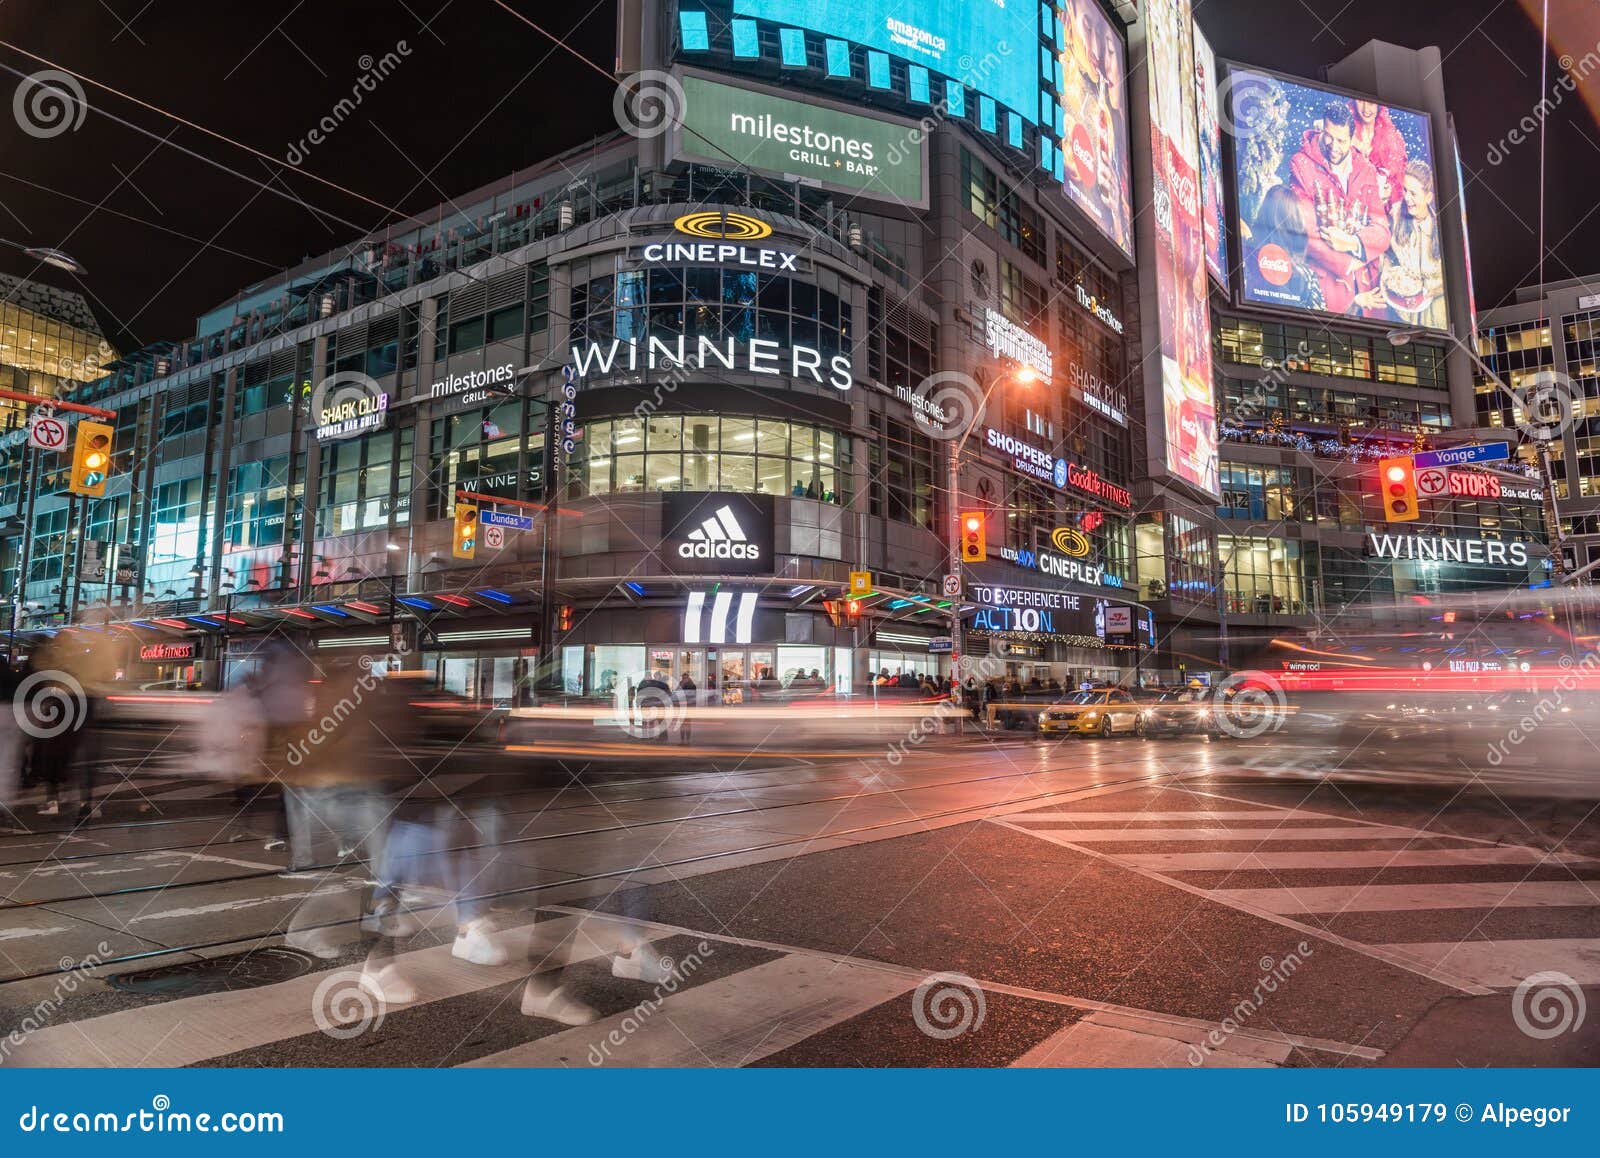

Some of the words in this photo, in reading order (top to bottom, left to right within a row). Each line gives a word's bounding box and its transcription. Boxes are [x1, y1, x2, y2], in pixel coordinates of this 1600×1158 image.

[886, 17, 946, 52] amazon.ca
[731, 112, 875, 160] milestones
[789, 149, 831, 168] GRILL
[643, 243, 798, 272] CINEPLEX
[571, 334, 853, 391] WINNERS
[431, 363, 514, 399] milestones
[1069, 362, 1103, 400] SHARK
[320, 401, 356, 426] SHARK
[358, 393, 388, 416] CLUB
[462, 390, 488, 404] GRILL
[896, 384, 945, 421] milestones
[316, 423, 342, 439] SPORTS
[344, 419, 358, 432] BAR
[360, 413, 381, 429] GRILL
[553, 406, 561, 473] DOWNTOWN
[987, 428, 1053, 471] SHOPPERS
[1436, 450, 1476, 463] Yonge
[1016, 459, 1035, 474] DRUG
[1035, 466, 1054, 482] MART
[1101, 482, 1131, 508] FITNESS
[1446, 472, 1500, 498] STOR'S
[1500, 486, 1516, 498] Bar
[1517, 488, 1529, 499] and
[490, 515, 519, 526] Dundas
[678, 539, 760, 560] adidas
[1370, 533, 1528, 567] WINNERS
[1039, 553, 1102, 587] CINEPLEX
[1103, 572, 1123, 588] IMAX
[974, 587, 992, 603] TO
[994, 588, 1061, 609] EXPERIENCE
[1061, 595, 1080, 611] THE
[164, 645, 190, 658] FITNESS
[1290, 663, 1307, 671] wine
